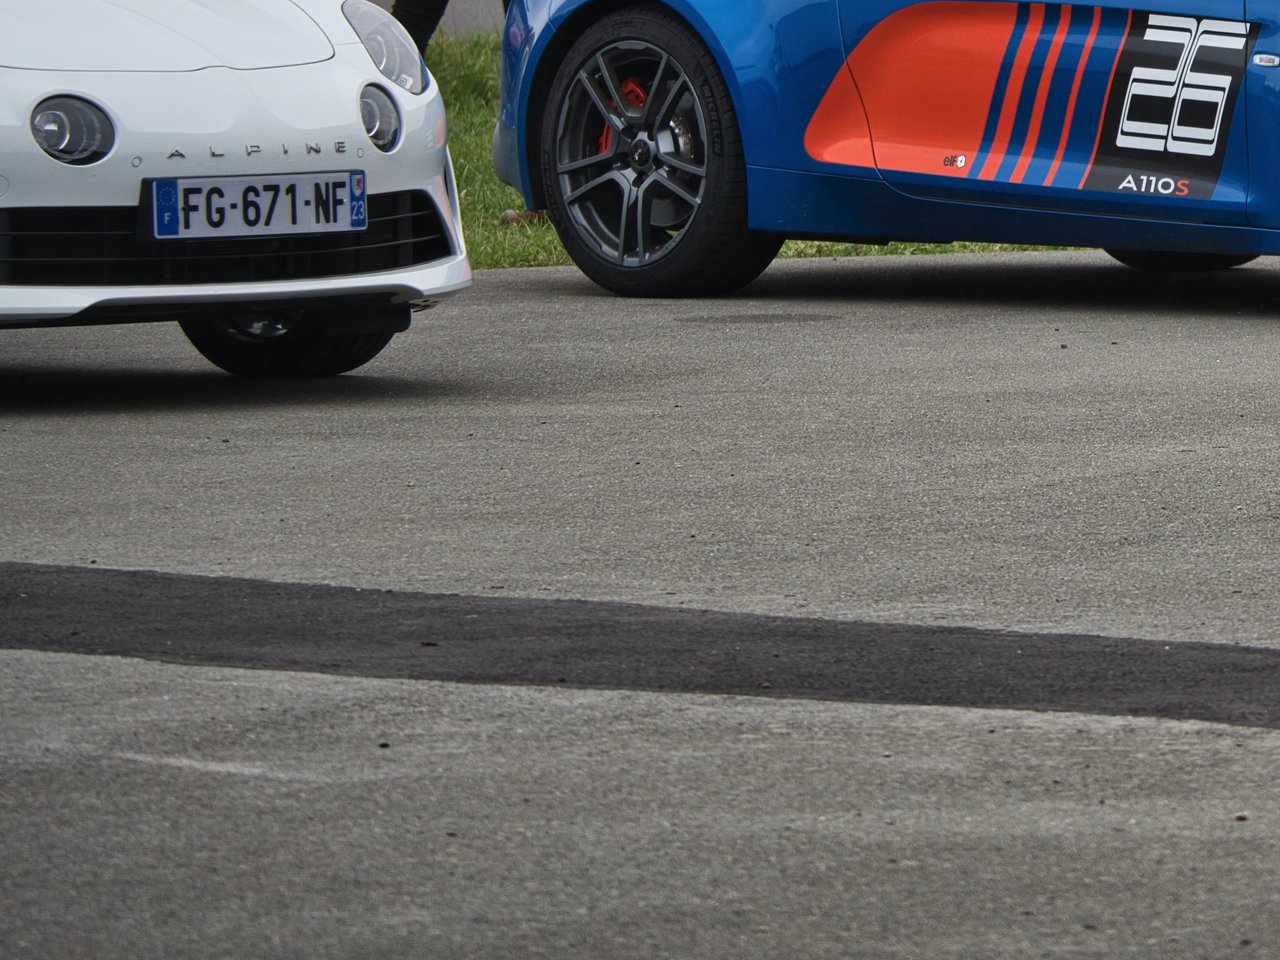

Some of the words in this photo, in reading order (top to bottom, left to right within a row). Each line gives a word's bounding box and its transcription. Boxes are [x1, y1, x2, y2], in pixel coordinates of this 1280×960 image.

[1116, 14, 1251, 157] 26
[167, 141, 346, 159] ALPINE
[1118, 173, 1189, 196] A110S
[164, 211, 172, 225] F
[181, 181, 347, 230] FG-671-NF
[351, 200, 366, 221] 23
